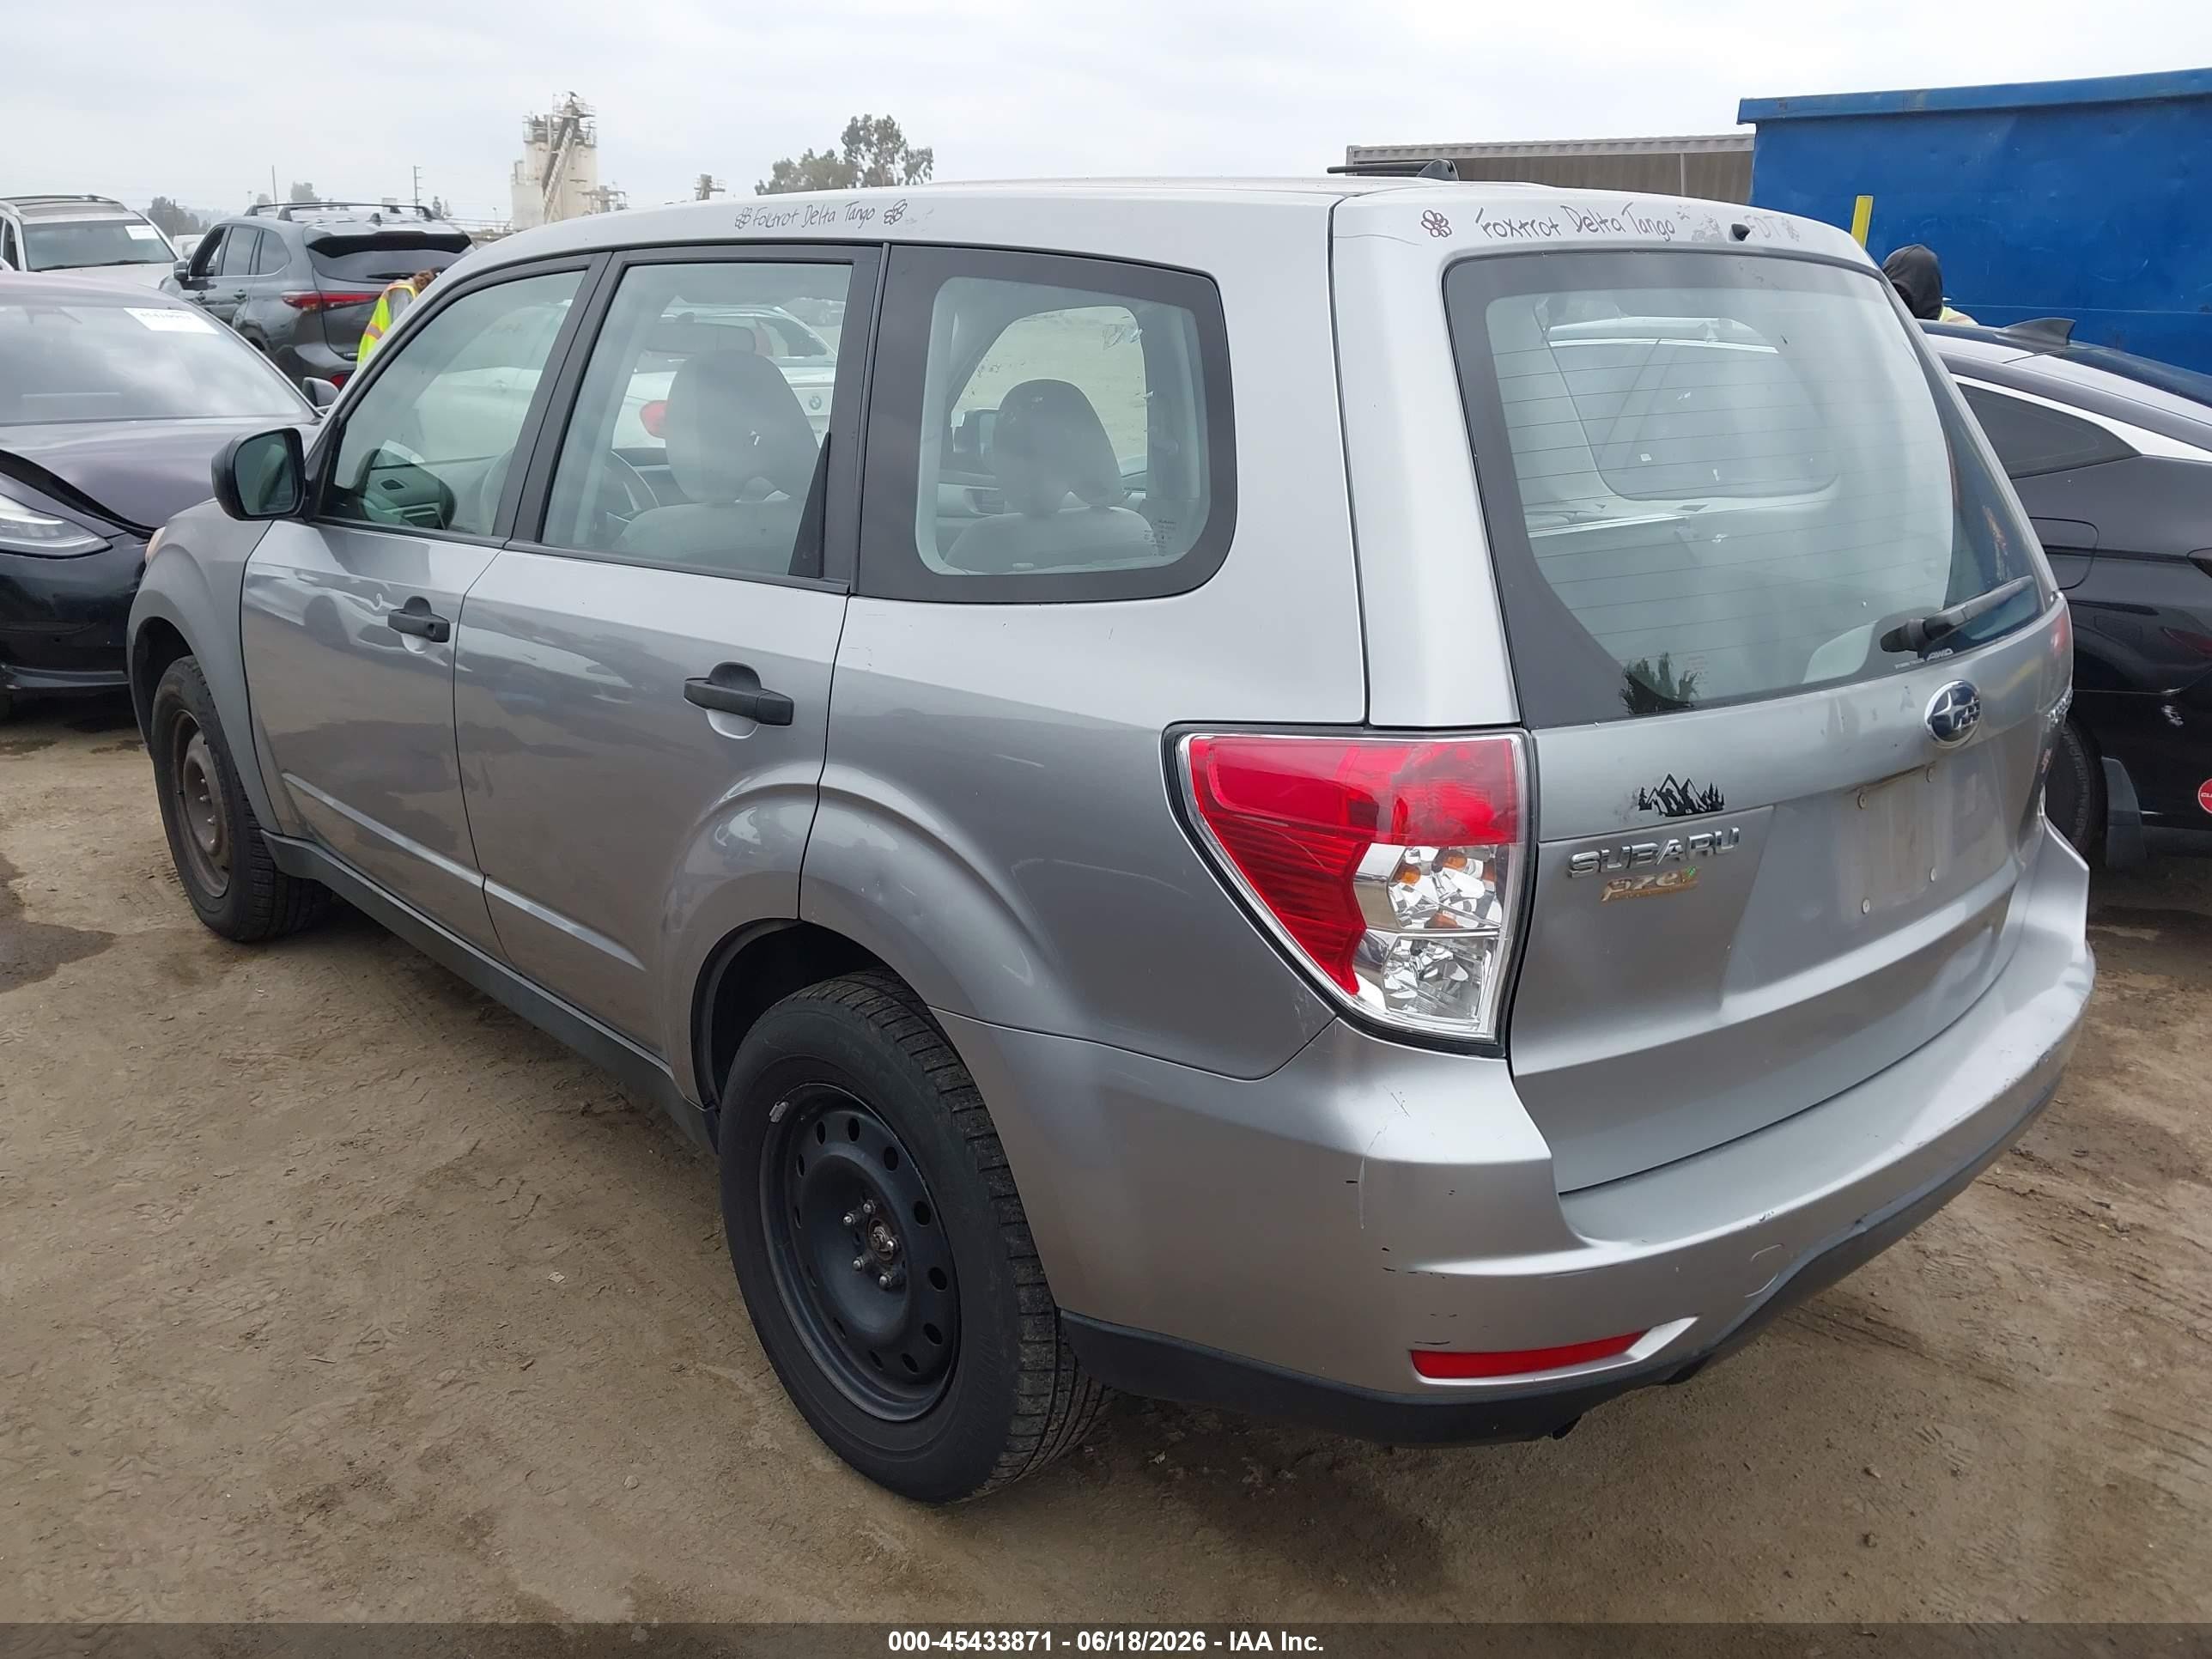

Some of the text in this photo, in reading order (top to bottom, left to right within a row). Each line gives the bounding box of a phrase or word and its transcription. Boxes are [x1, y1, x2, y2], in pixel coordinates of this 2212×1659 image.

[800, 204, 836, 228] Delta
[844, 200, 876, 229] Tango
[1559, 204, 1626, 234] Delta
[1621, 201, 1676, 242] Tango
[1567, 827, 1741, 878] SUBARU
